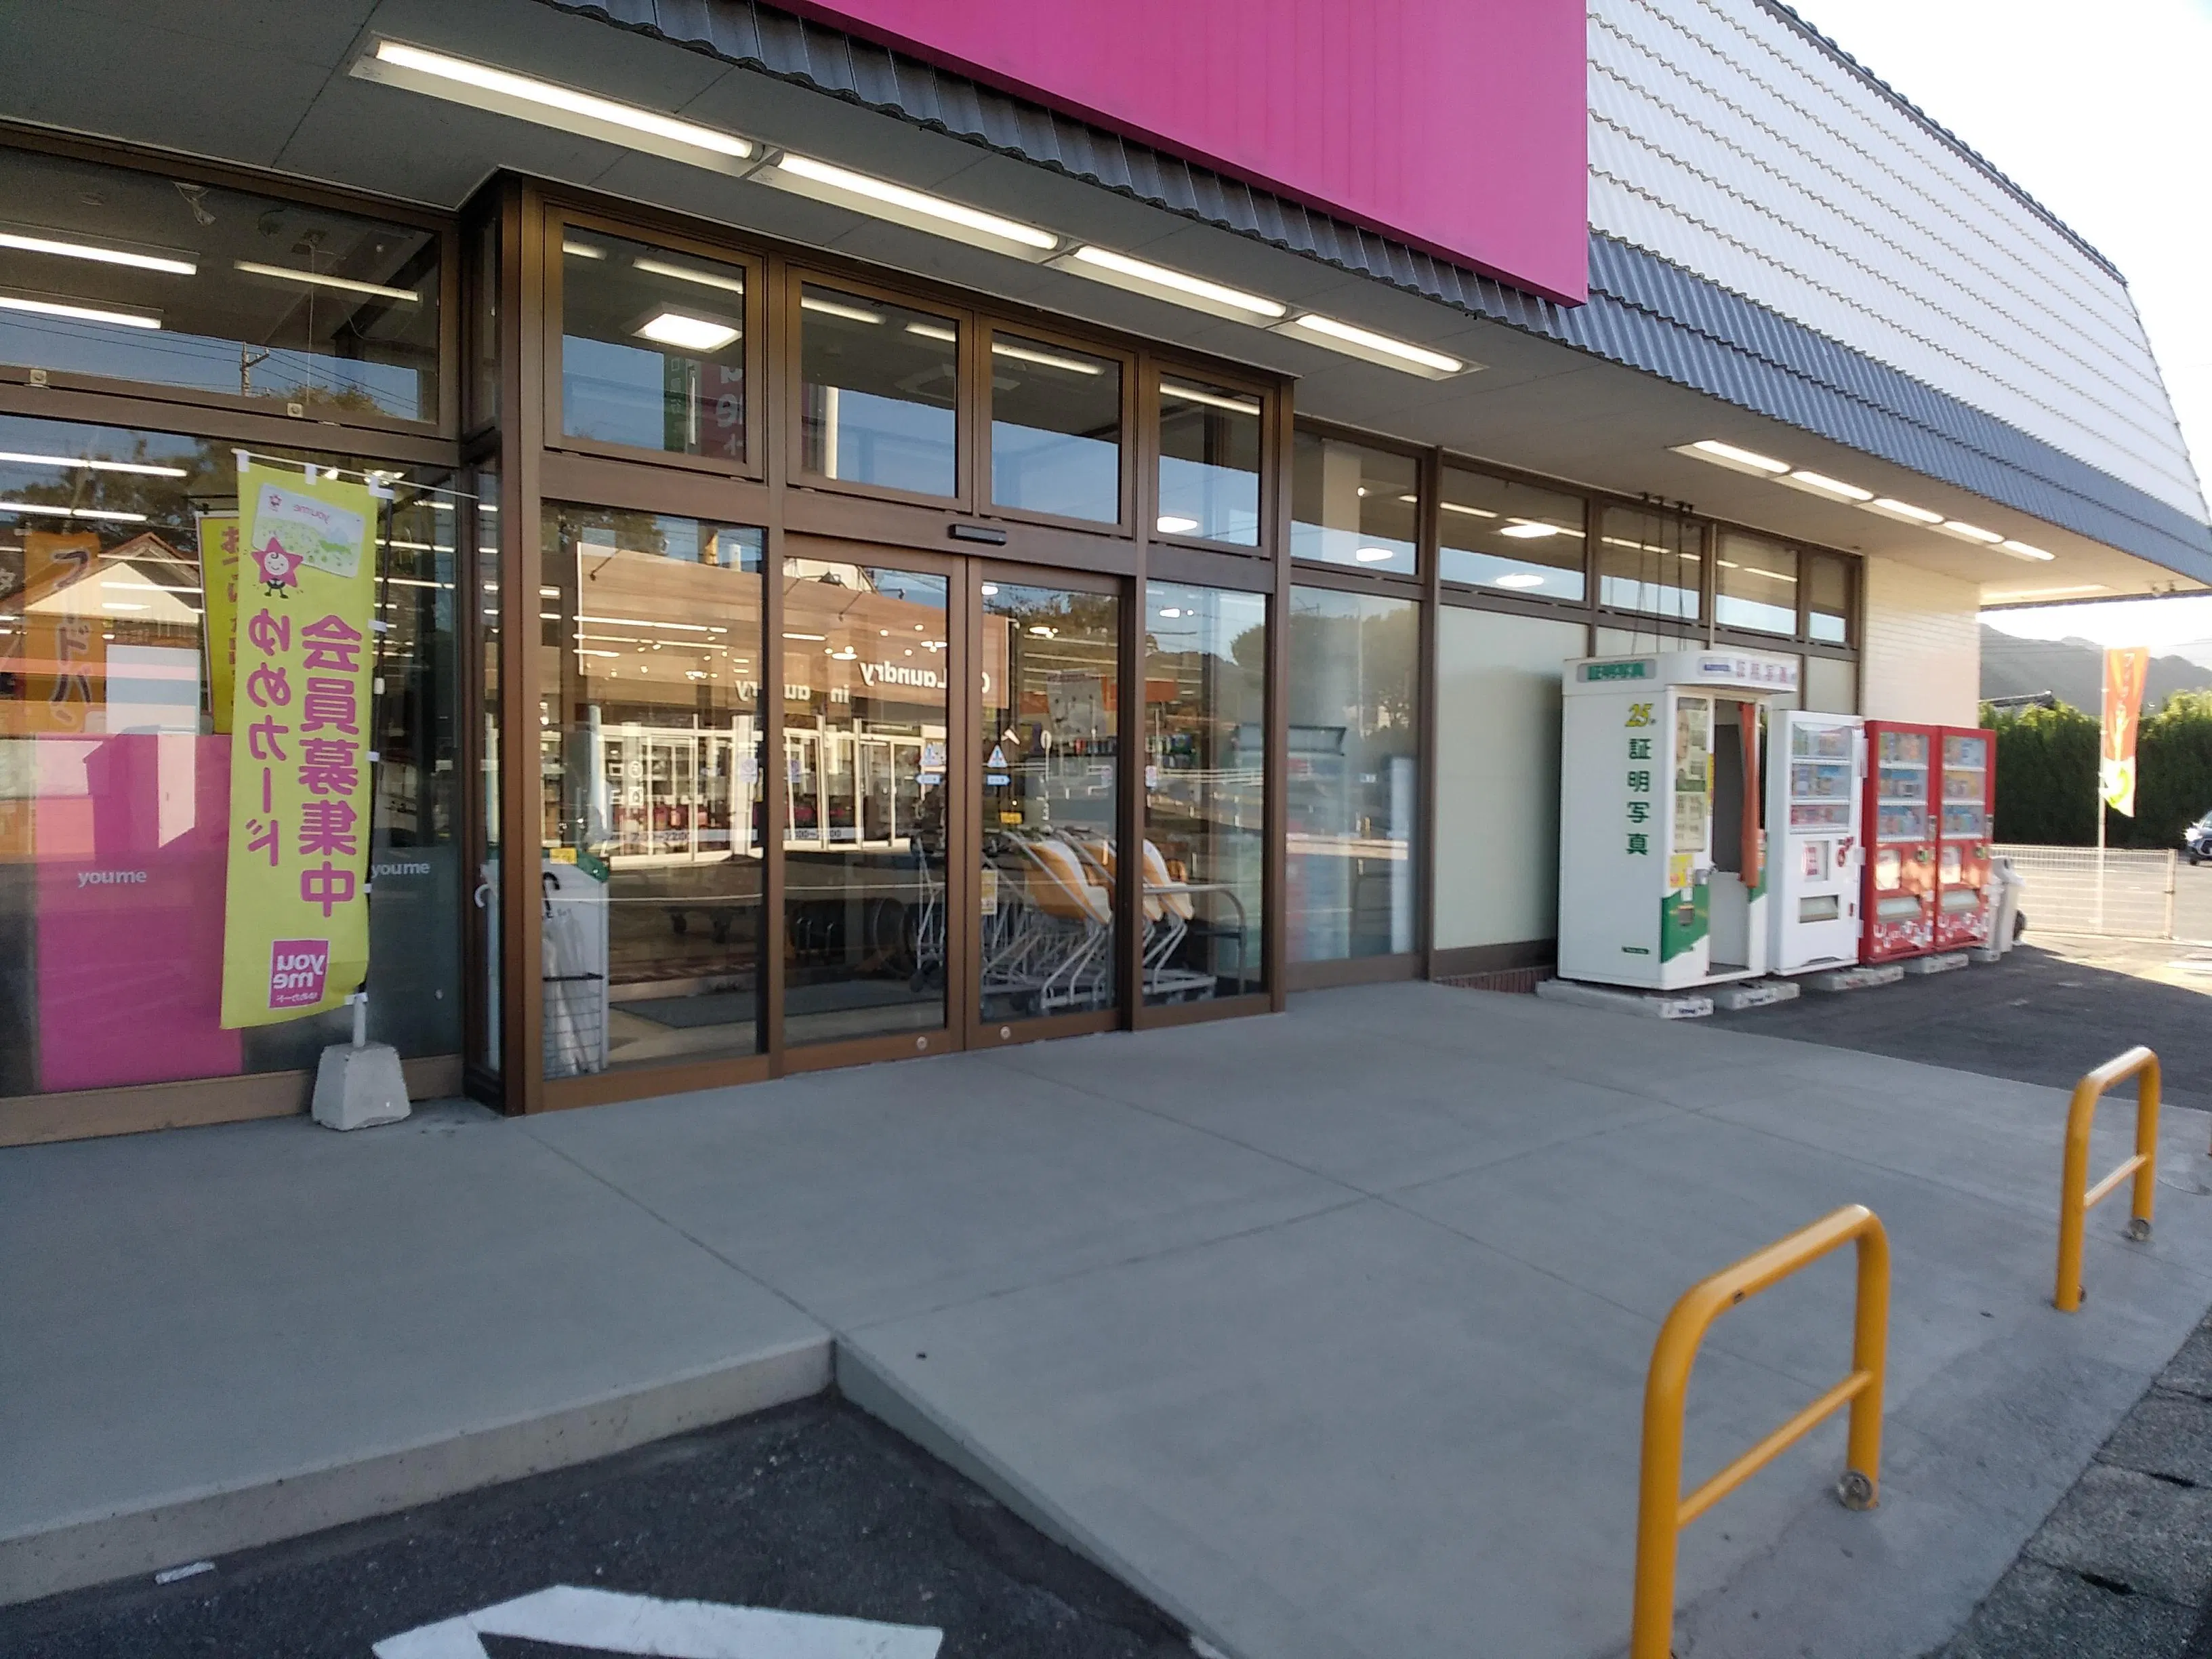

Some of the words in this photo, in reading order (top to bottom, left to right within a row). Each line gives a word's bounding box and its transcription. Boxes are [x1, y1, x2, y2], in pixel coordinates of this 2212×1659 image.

[1626, 737, 1652, 855] 証明写真
[77, 870, 148, 889] youme
[370, 862, 431, 879] youme
